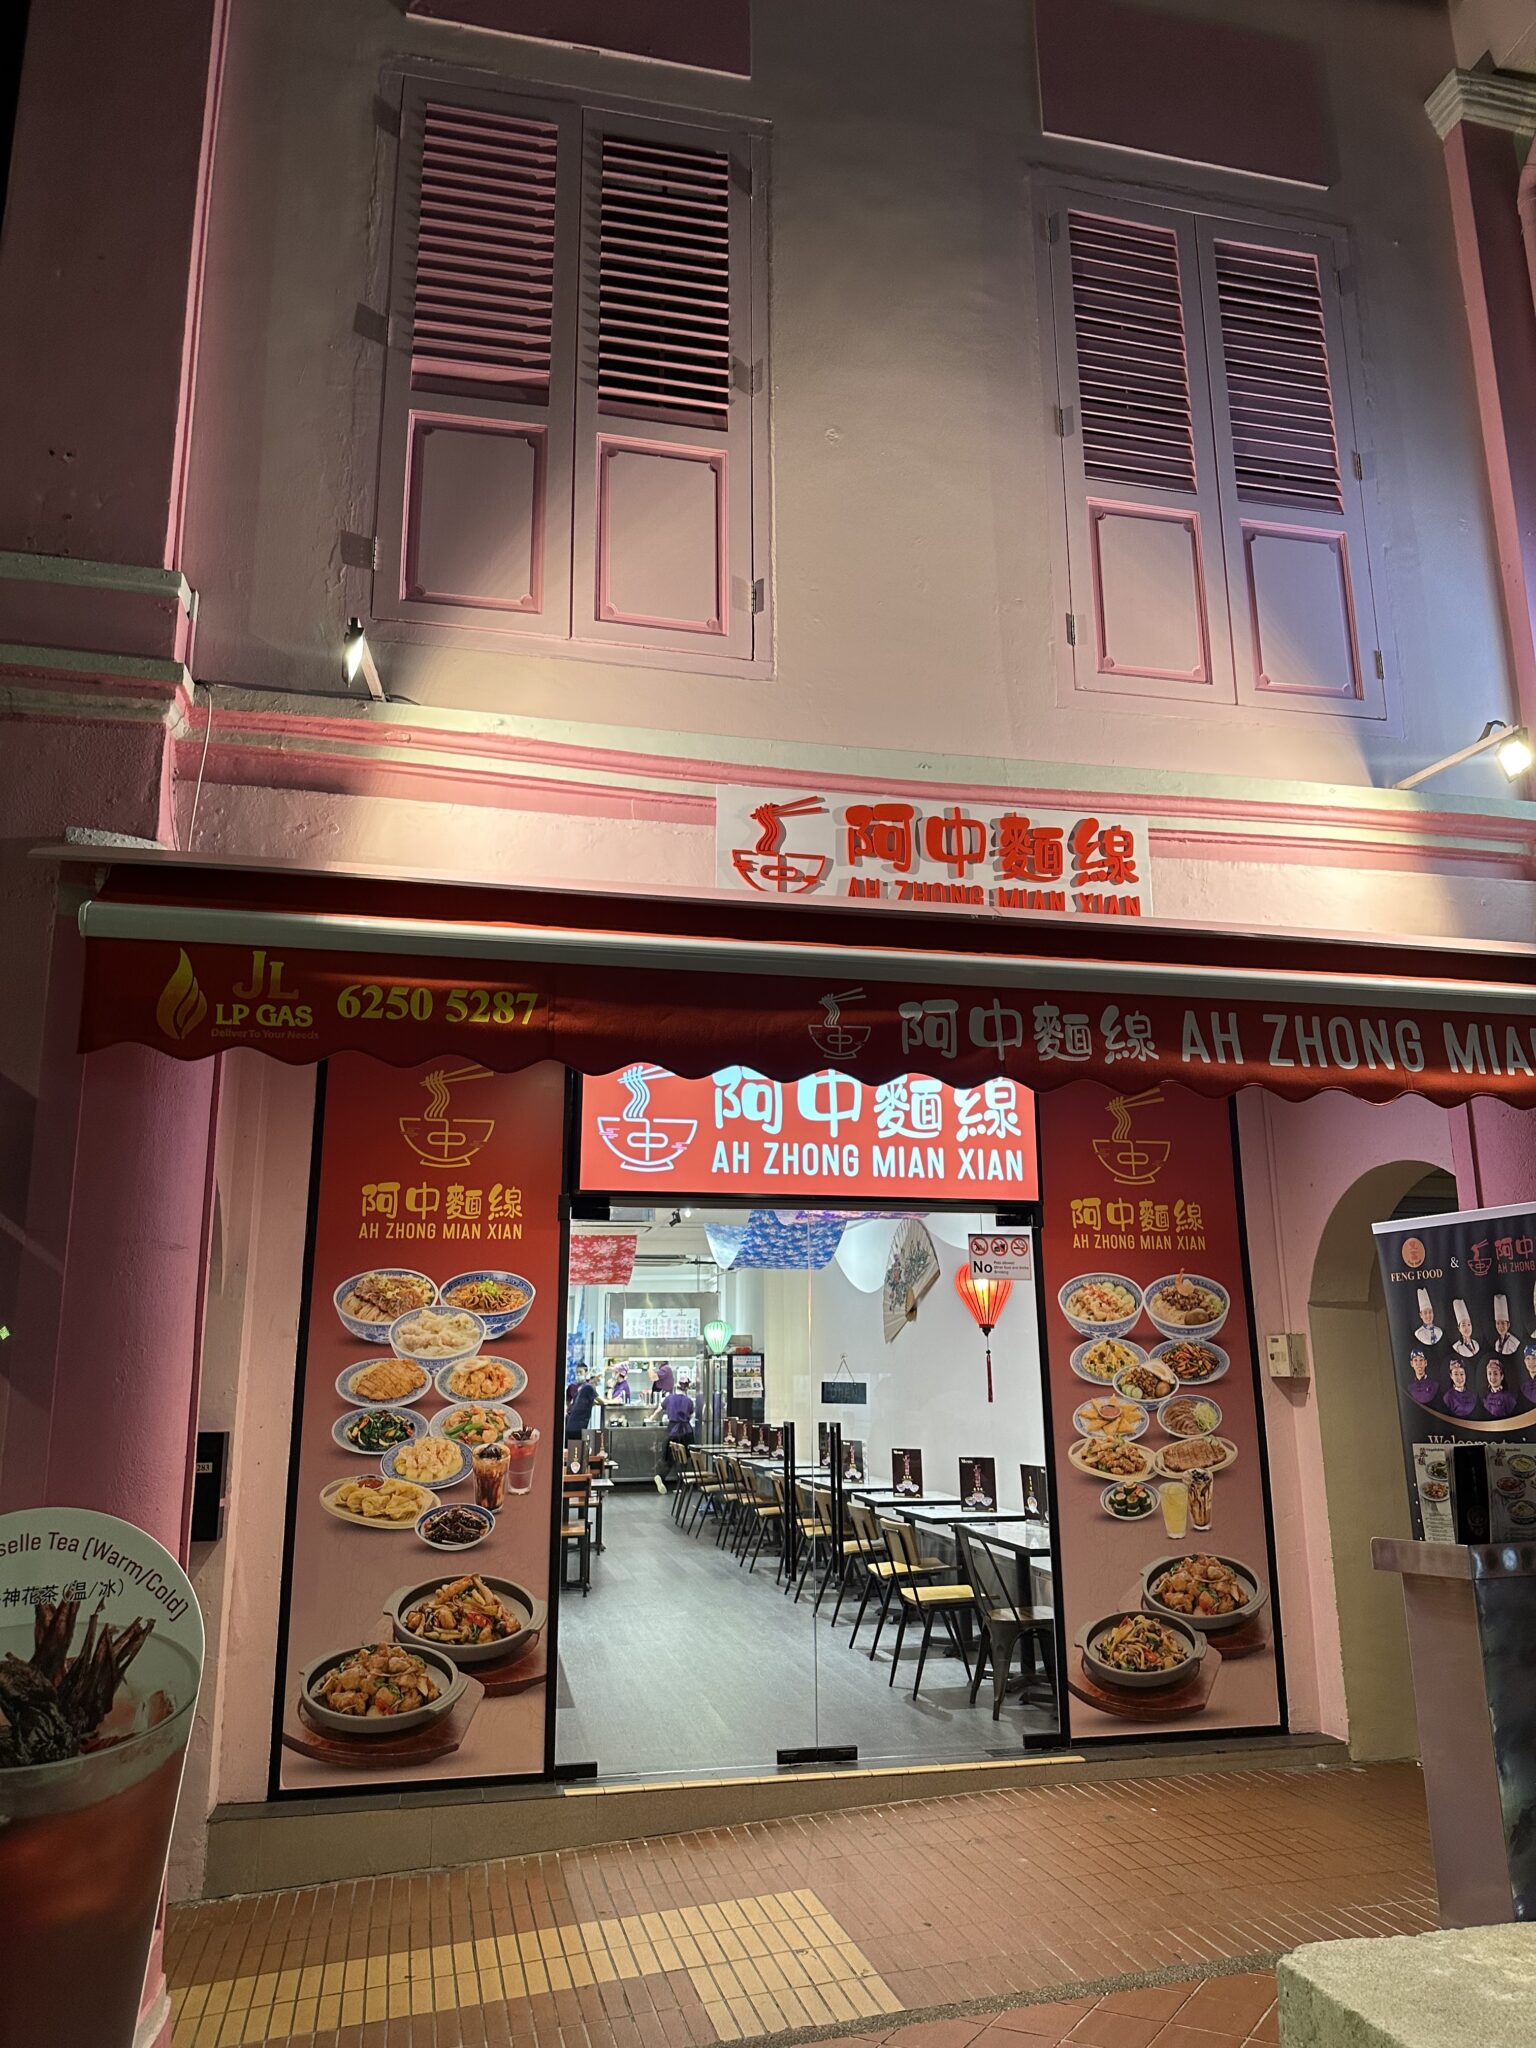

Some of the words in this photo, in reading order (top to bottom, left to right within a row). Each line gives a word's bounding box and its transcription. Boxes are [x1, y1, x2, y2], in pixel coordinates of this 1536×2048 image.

[845, 803, 1139, 887] 阿中麵線
[232, 950, 299, 1000] JL
[215, 1004, 250, 1026] LP
[256, 1005, 313, 1027] GAS
[337, 984, 433, 1021] 6250
[445, 990, 538, 1025] 5287
[261, 1030, 287, 1039] Your
[899, 998, 1159, 1064] 阿中麵線
[1182, 1010, 1244, 1064] AH
[1263, 1014, 1425, 1072] ZHONG
[1443, 1022, 1536, 1077] MIA
[712, 1065, 1021, 1142] 阿中麵線
[711, 1141, 750, 1174] AH
[763, 1142, 860, 1177] ZHONG
[872, 1145, 945, 1179] MIAN
[957, 1148, 1024, 1181] XIAN
[361, 1181, 523, 1221] 阿中麵線
[1070, 1197, 1204, 1233] 阿中麵線
[359, 1222, 379, 1239] AH
[386, 1222, 436, 1239] ZHONG
[442, 1223, 481, 1239] MIAN
[487, 1223, 523, 1240] XIAN
[1073, 1234, 1089, 1249] AH
[1094, 1234, 1135, 1249] ZHONG
[1140, 1235, 1171, 1250] MIAN
[1177, 1235, 1206, 1250] XIAN
[973, 1260, 993, 1273] No
[1391, 1271, 1415, 1282] FENG
[1416, 1268, 1443, 1280] FOOD
[1450, 1256, 1459, 1268] &
[1497, 1263, 1508, 1273] AH
[1509, 1260, 1535, 1273] ZHONG
[48, 1531, 80, 1553] Tea
[0, 1578, 124, 1608] 神花茶(温/冰)
